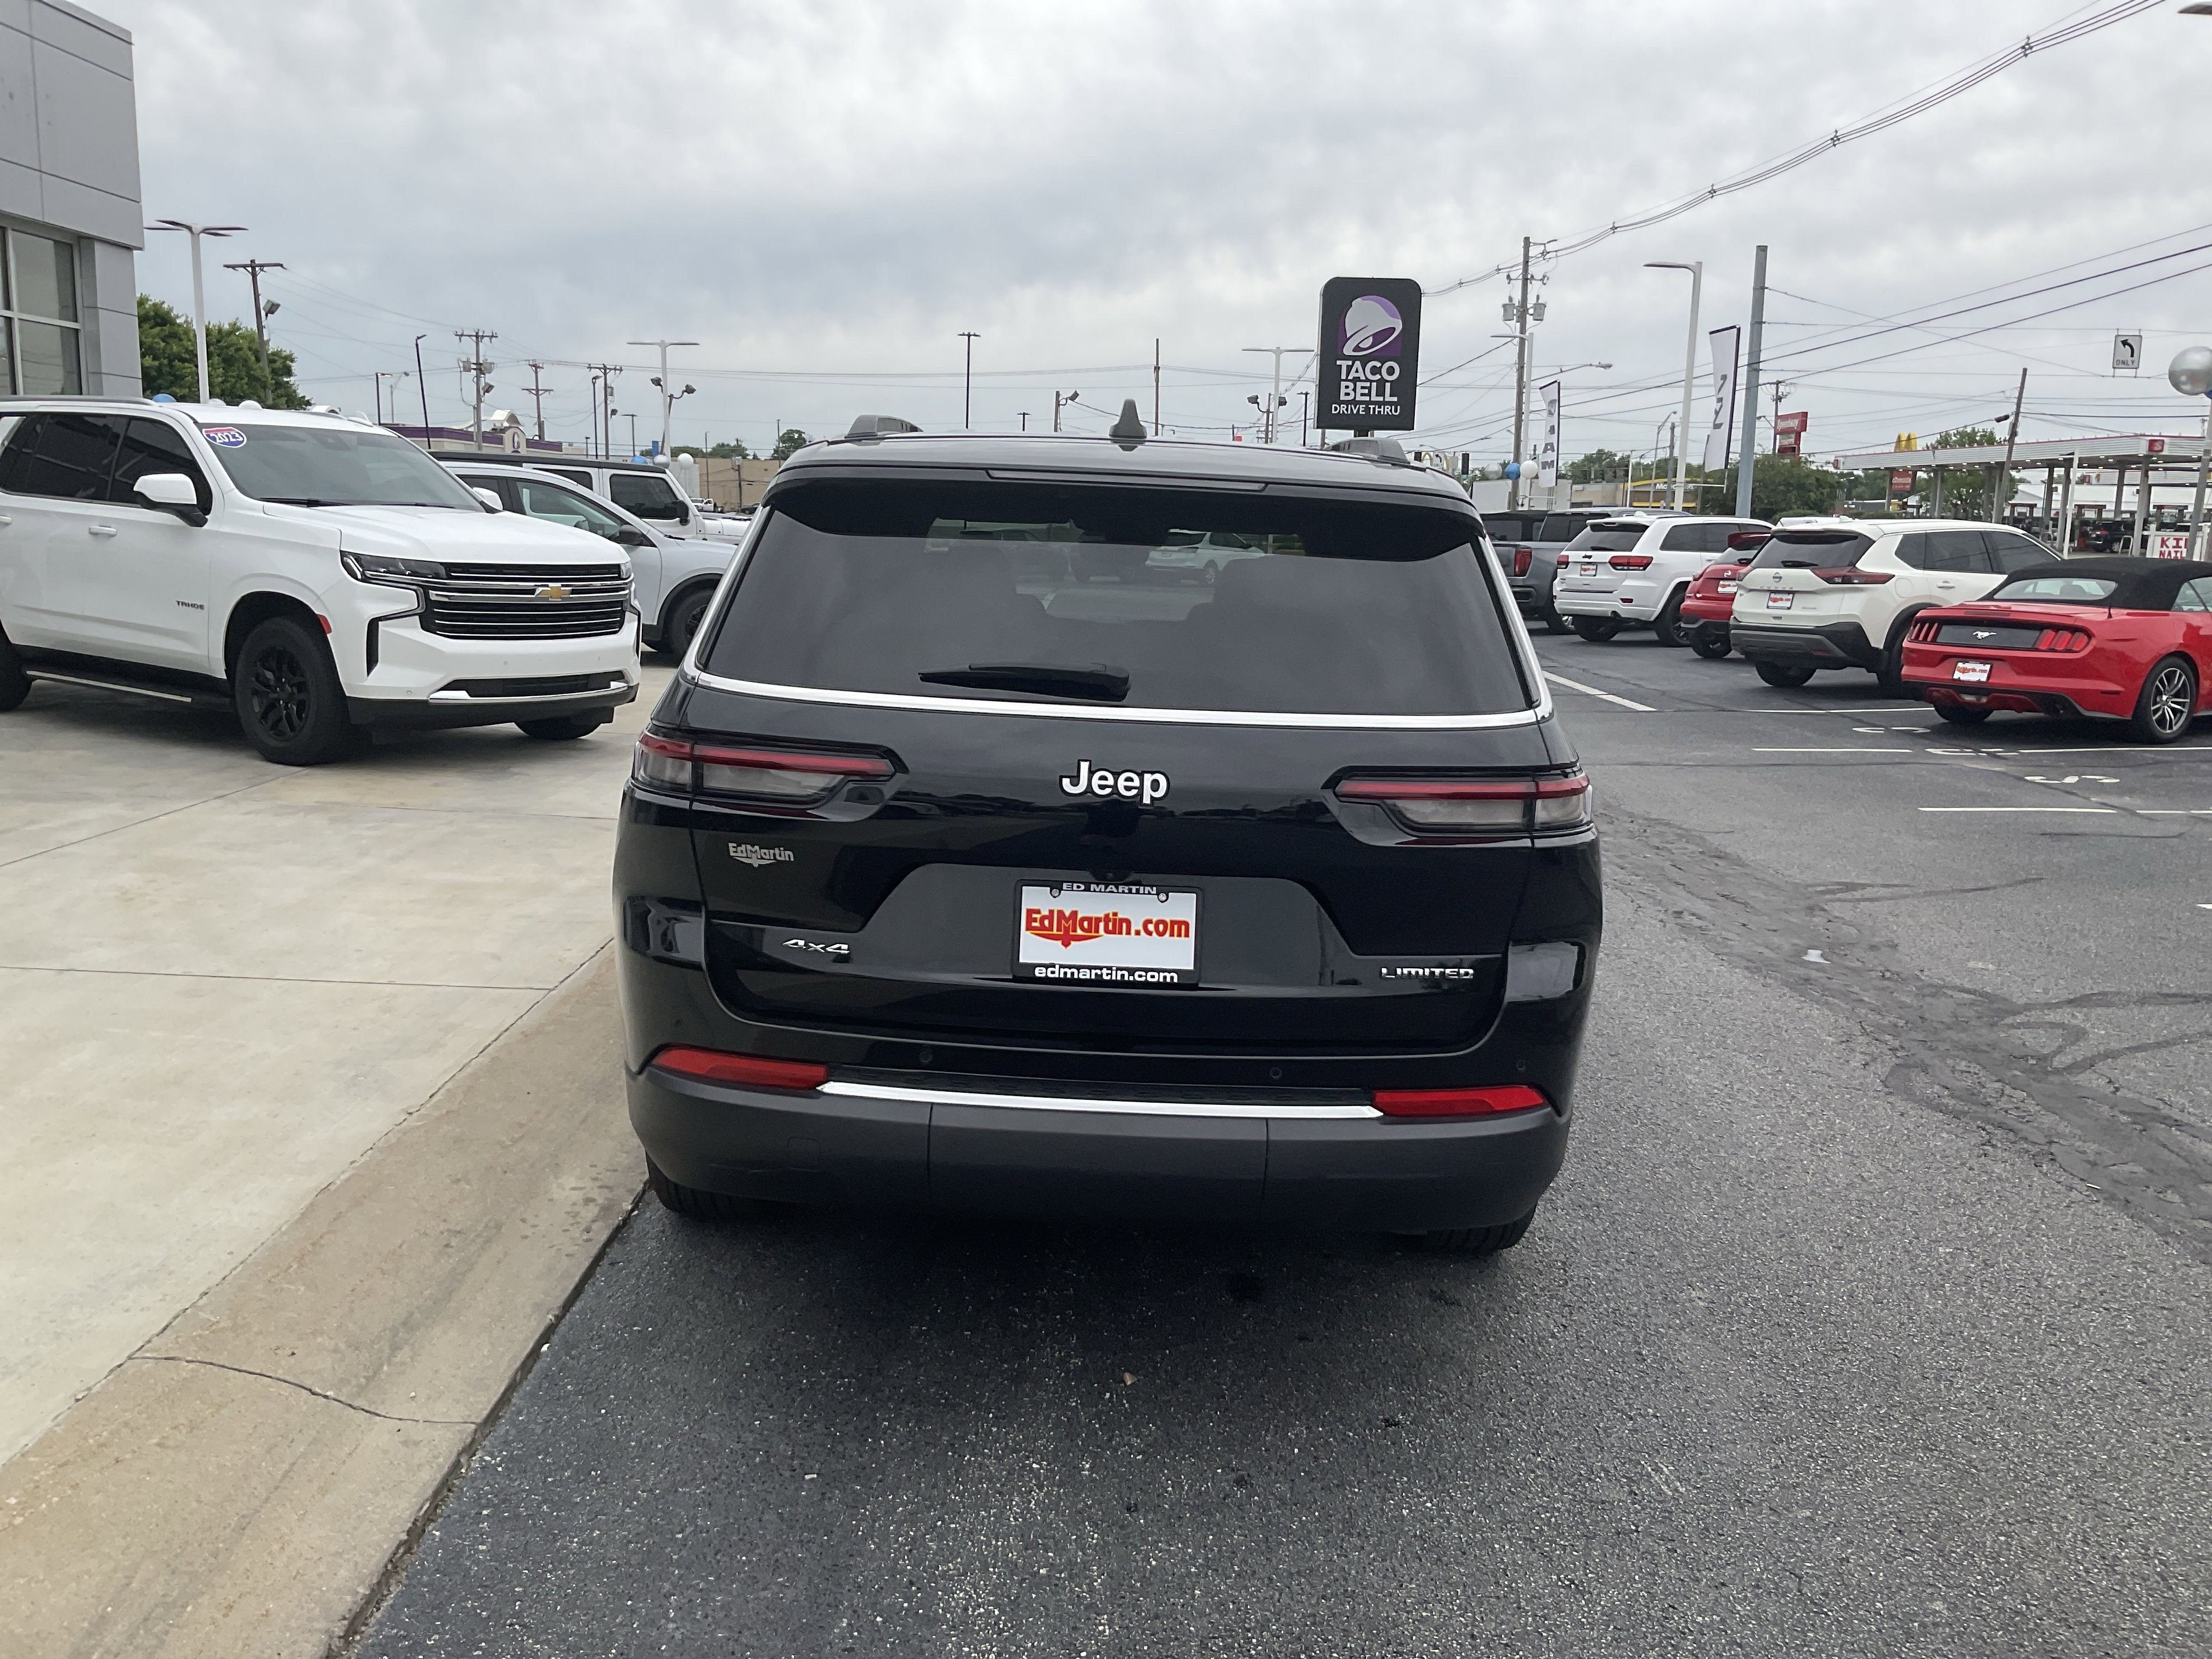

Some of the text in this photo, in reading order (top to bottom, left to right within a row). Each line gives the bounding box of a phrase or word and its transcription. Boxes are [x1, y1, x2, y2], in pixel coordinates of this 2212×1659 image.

[1336, 360, 1400, 381] TACO
[1340, 381, 1398, 402] BELL
[1331, 404, 1400, 415] DRIVE THRU
[210, 432, 243, 443] 2023
[176, 600, 205, 610] TAHOE
[1061, 760, 1169, 805] Jeep
[728, 842, 794, 867] EdMartin
[1062, 882, 1156, 895] ED MARTIN
[1025, 907, 1190, 948] EdMartin.com
[1035, 964, 1178, 983] edmartin.com
[1381, 968, 1474, 979] LIMITED
